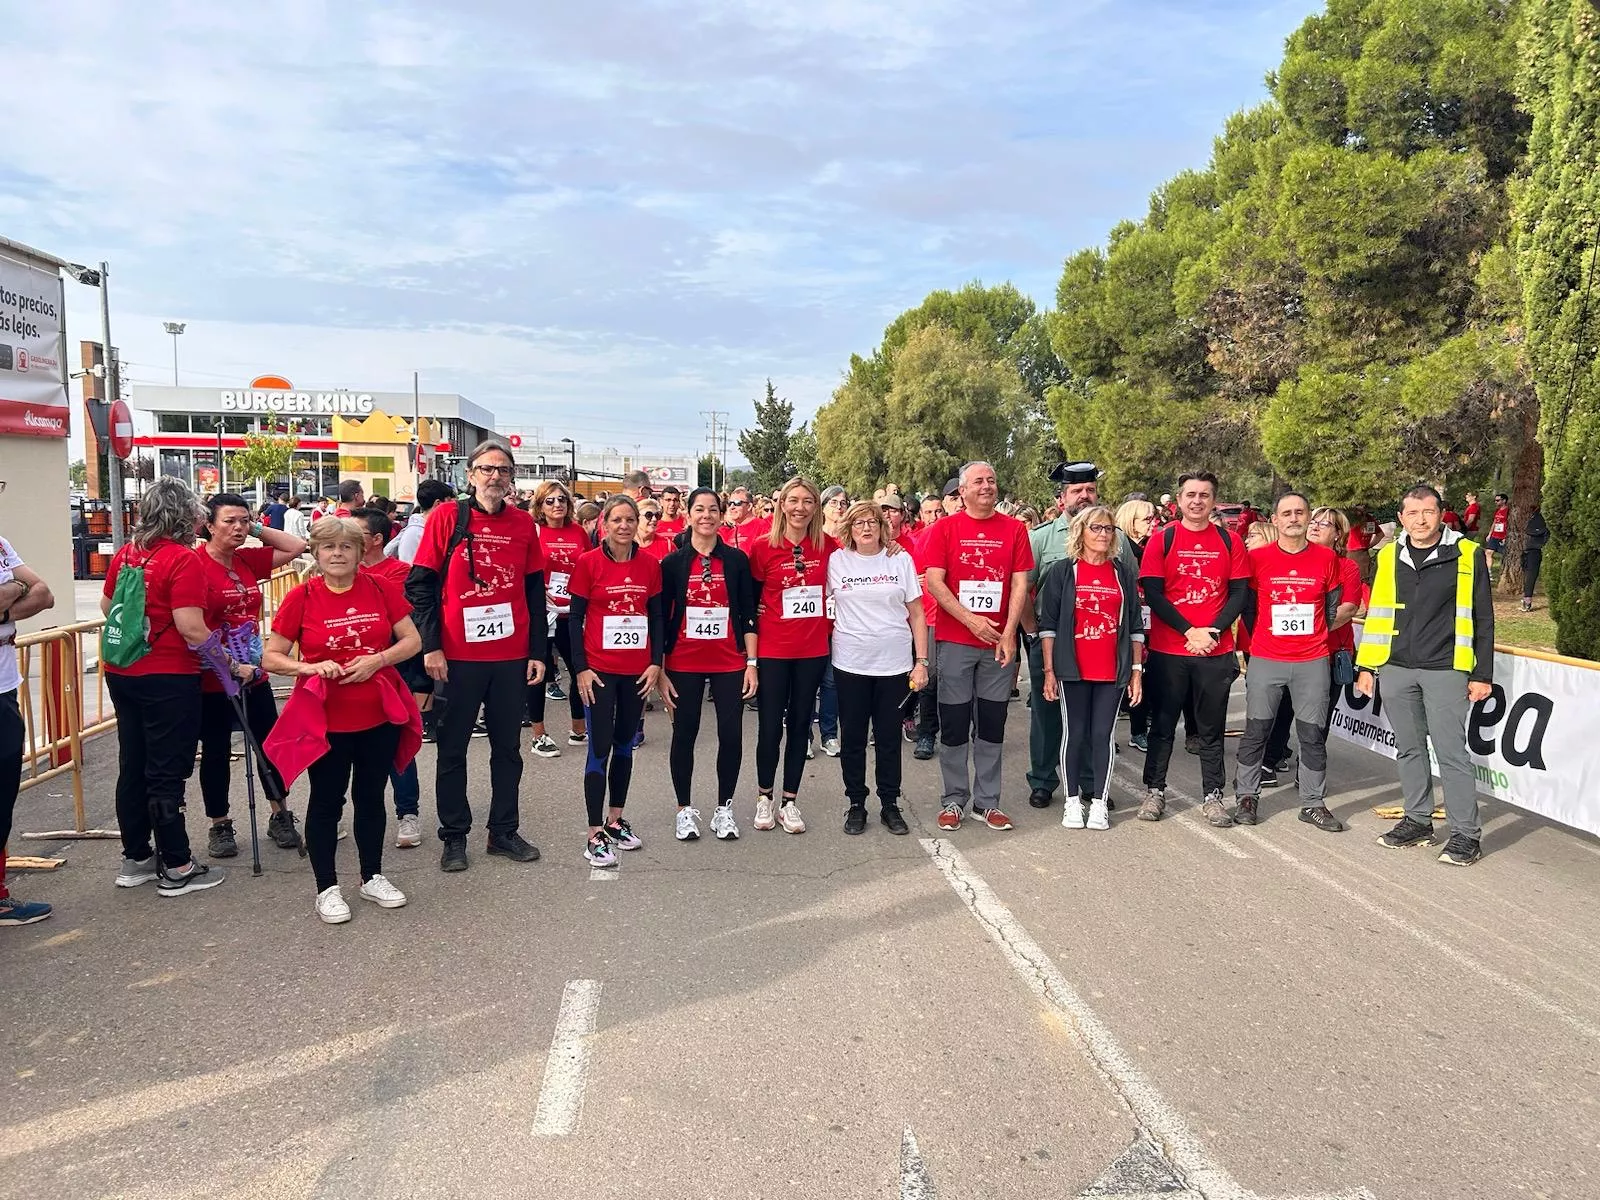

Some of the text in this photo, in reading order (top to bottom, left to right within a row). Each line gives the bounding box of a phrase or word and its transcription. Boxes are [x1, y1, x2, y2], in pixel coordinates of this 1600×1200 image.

[19, 295, 57, 321] precios,
[12, 314, 41, 340] lejos.
[221, 391, 373, 413] BURGER KING
[24, 410, 63, 431] Alcampo
[556, 584, 568, 596] 28
[792, 601, 815, 614] 240
[968, 596, 993, 608] 179
[476, 621, 504, 638] 241
[695, 623, 720, 636] 445
[1281, 619, 1305, 632] 361
[613, 632, 640, 645] 239
[1331, 707, 1398, 749] Tu supermerca
[1468, 683, 1555, 771] ea
[1472, 765, 1509, 789] ampo
